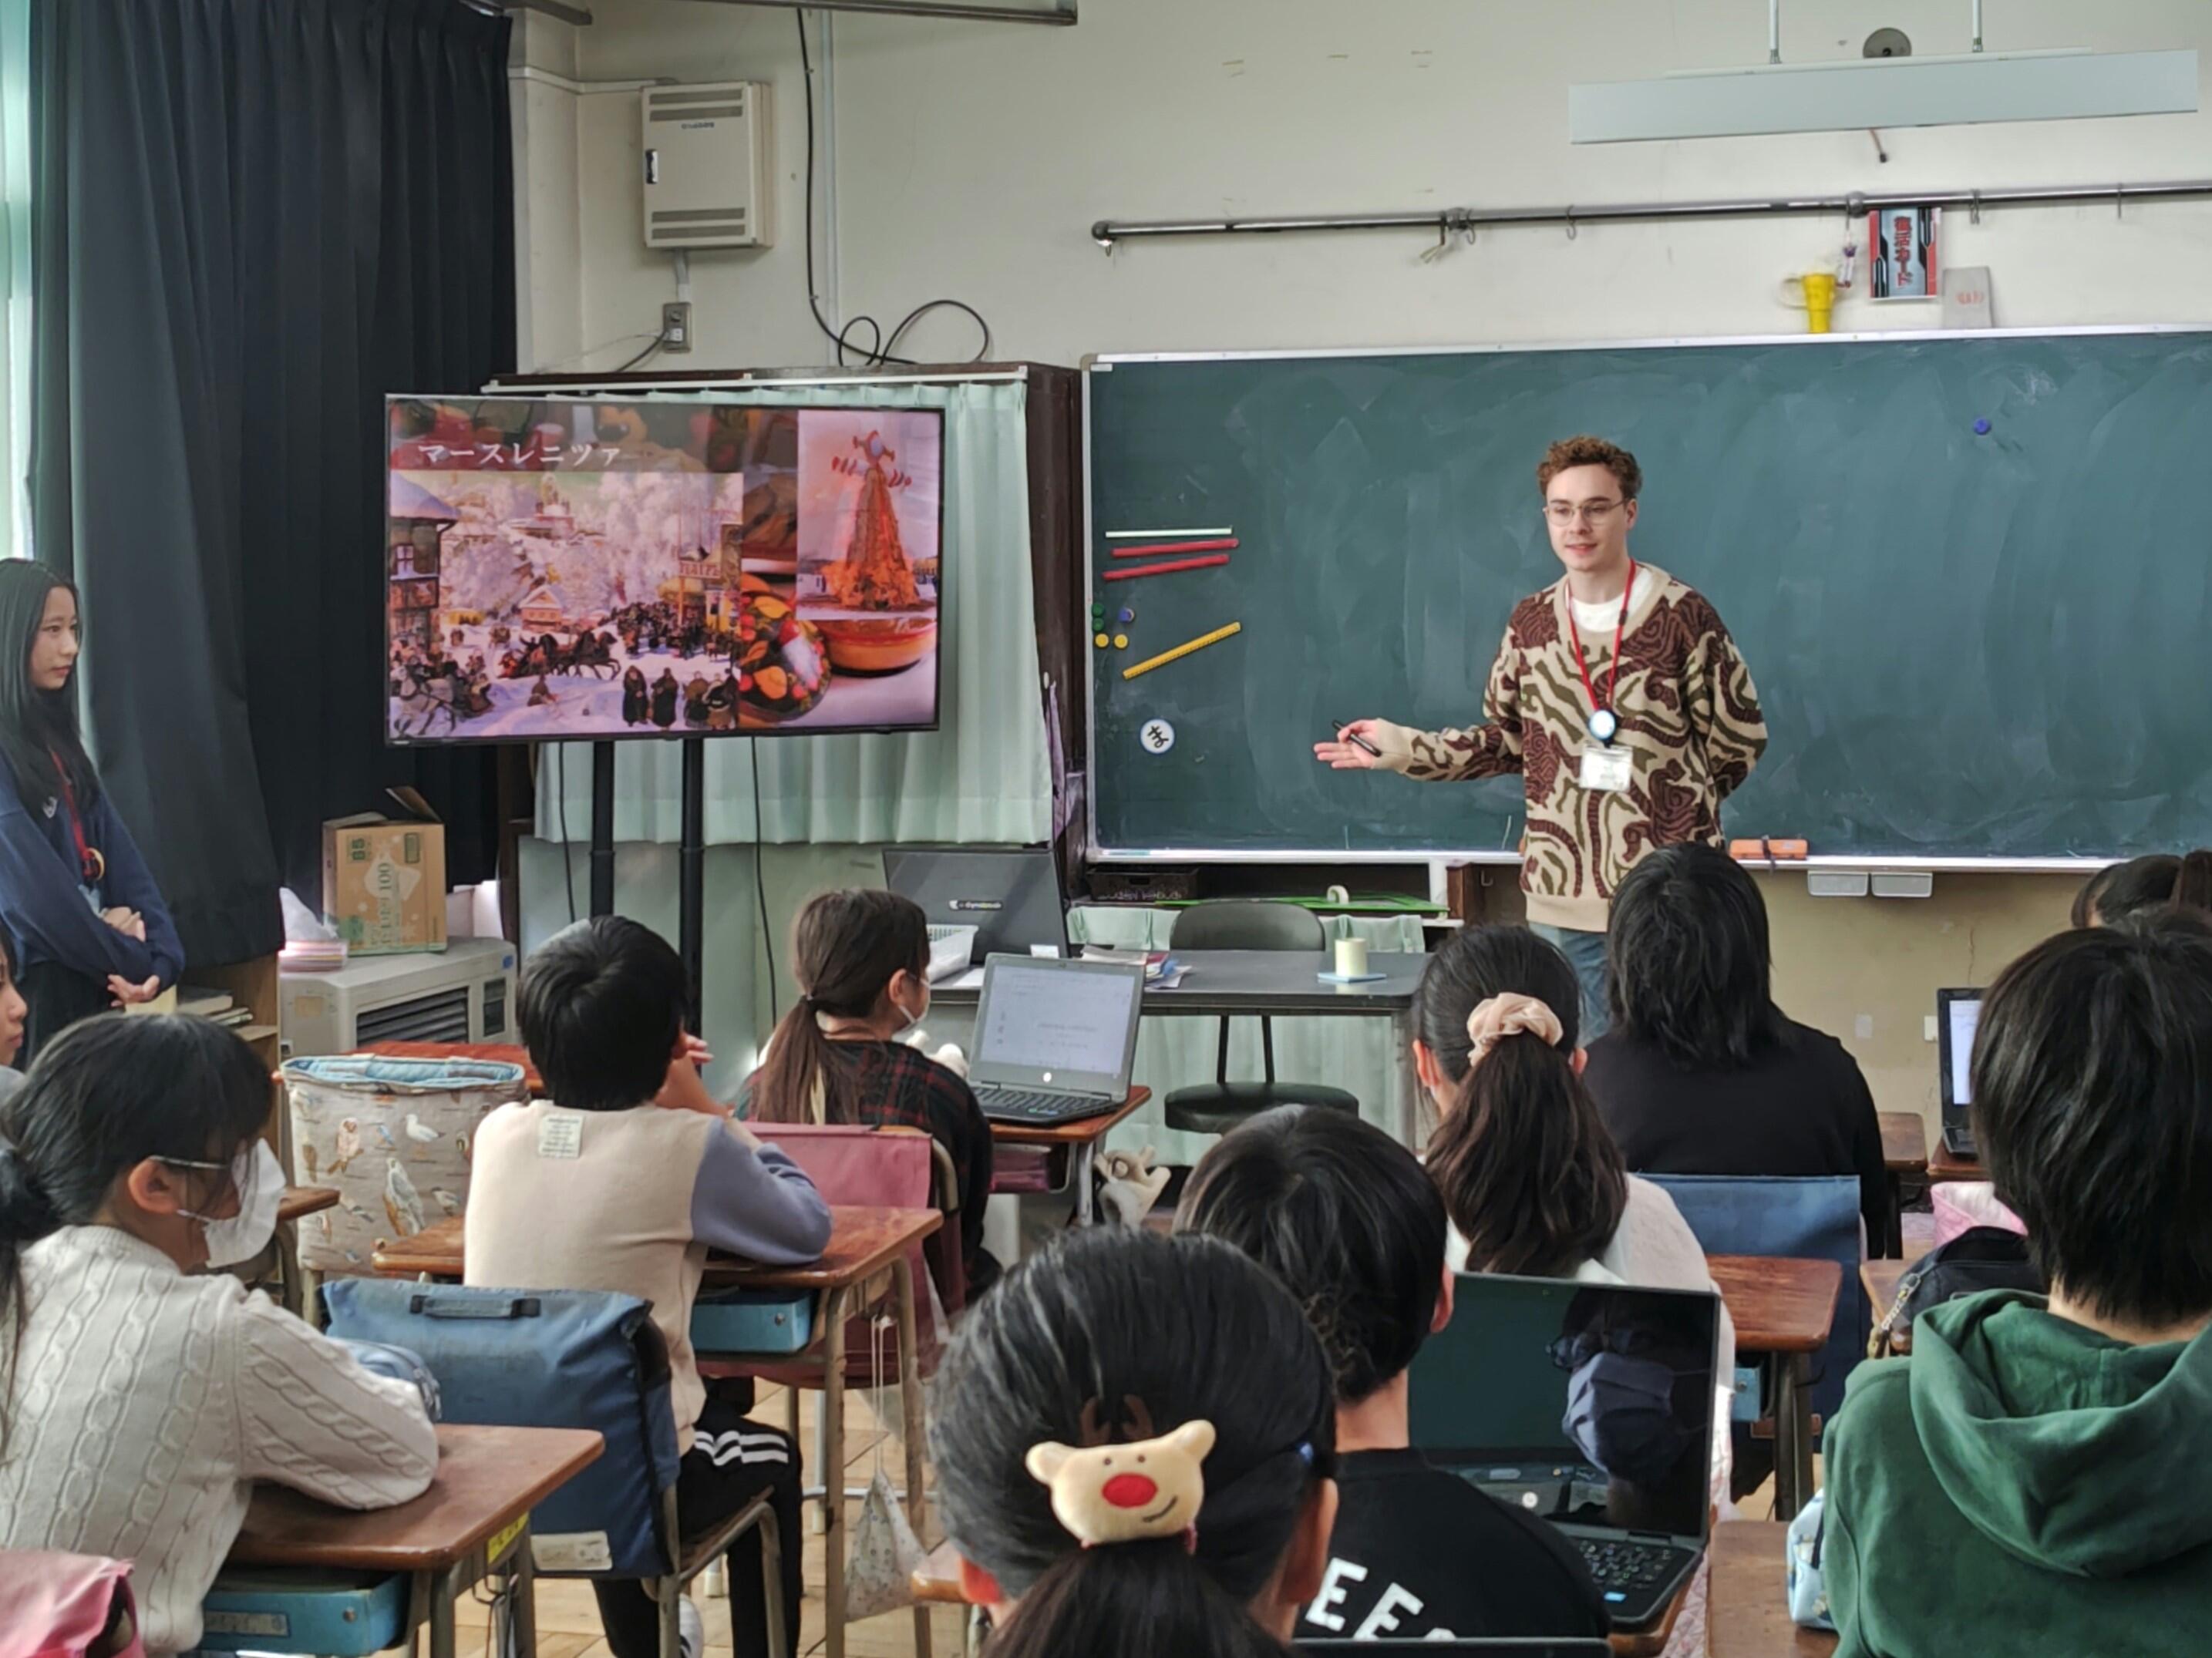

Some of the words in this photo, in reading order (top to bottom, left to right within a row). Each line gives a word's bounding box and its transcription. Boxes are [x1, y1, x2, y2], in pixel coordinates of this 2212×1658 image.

[418, 442, 621, 467] マースレニツァ
[1146, 725, 1170, 748] ま
[1305, 1557, 1460, 1641] EE
